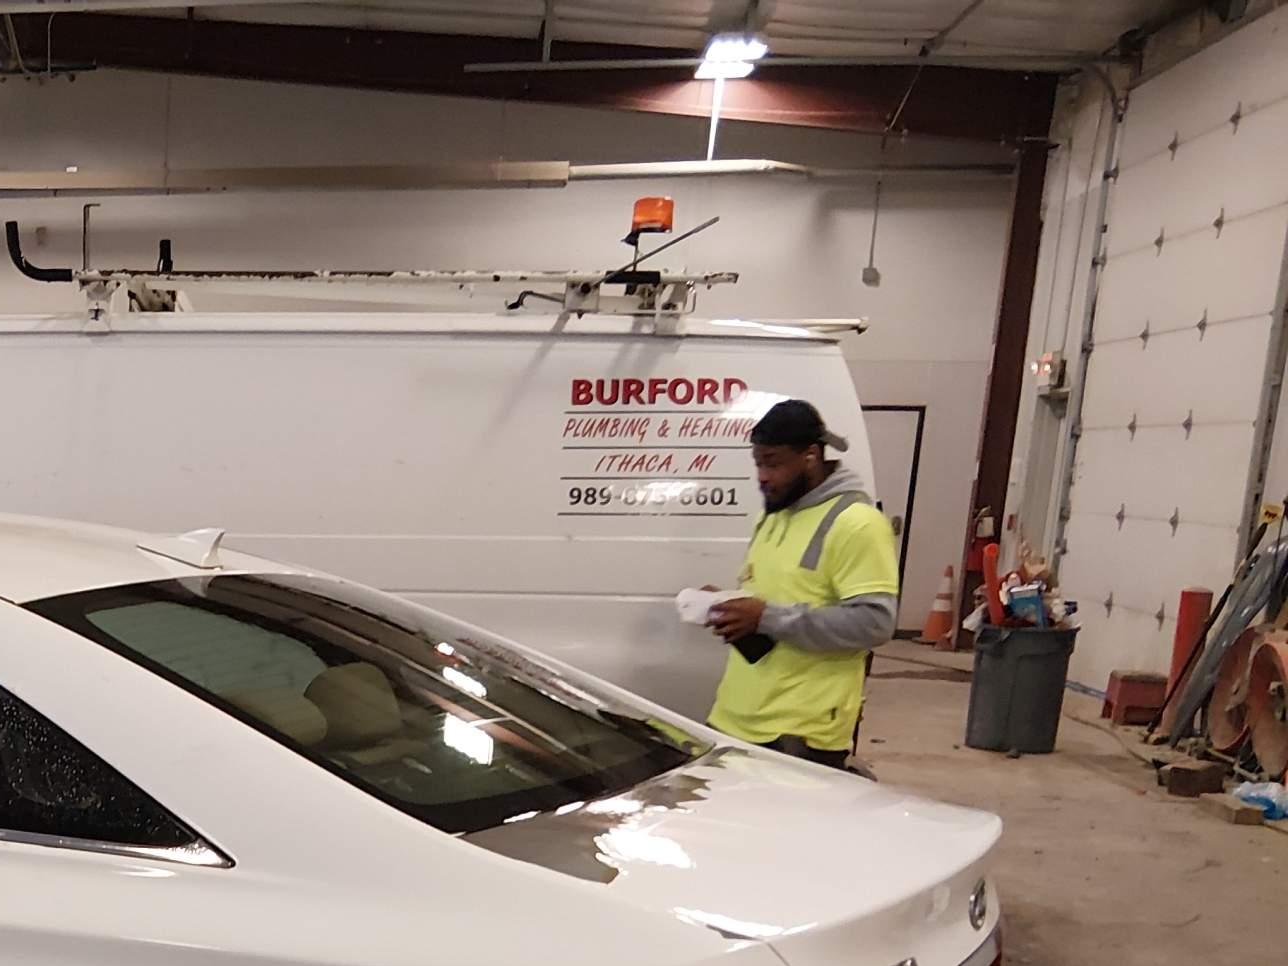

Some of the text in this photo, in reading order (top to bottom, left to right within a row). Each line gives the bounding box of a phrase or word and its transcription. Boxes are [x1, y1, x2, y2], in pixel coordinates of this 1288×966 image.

[571, 378, 748, 406] BURFORD
[563, 417, 752, 443] PLUMBING & HEATING
[594, 453, 717, 474] ITHACA, MI
